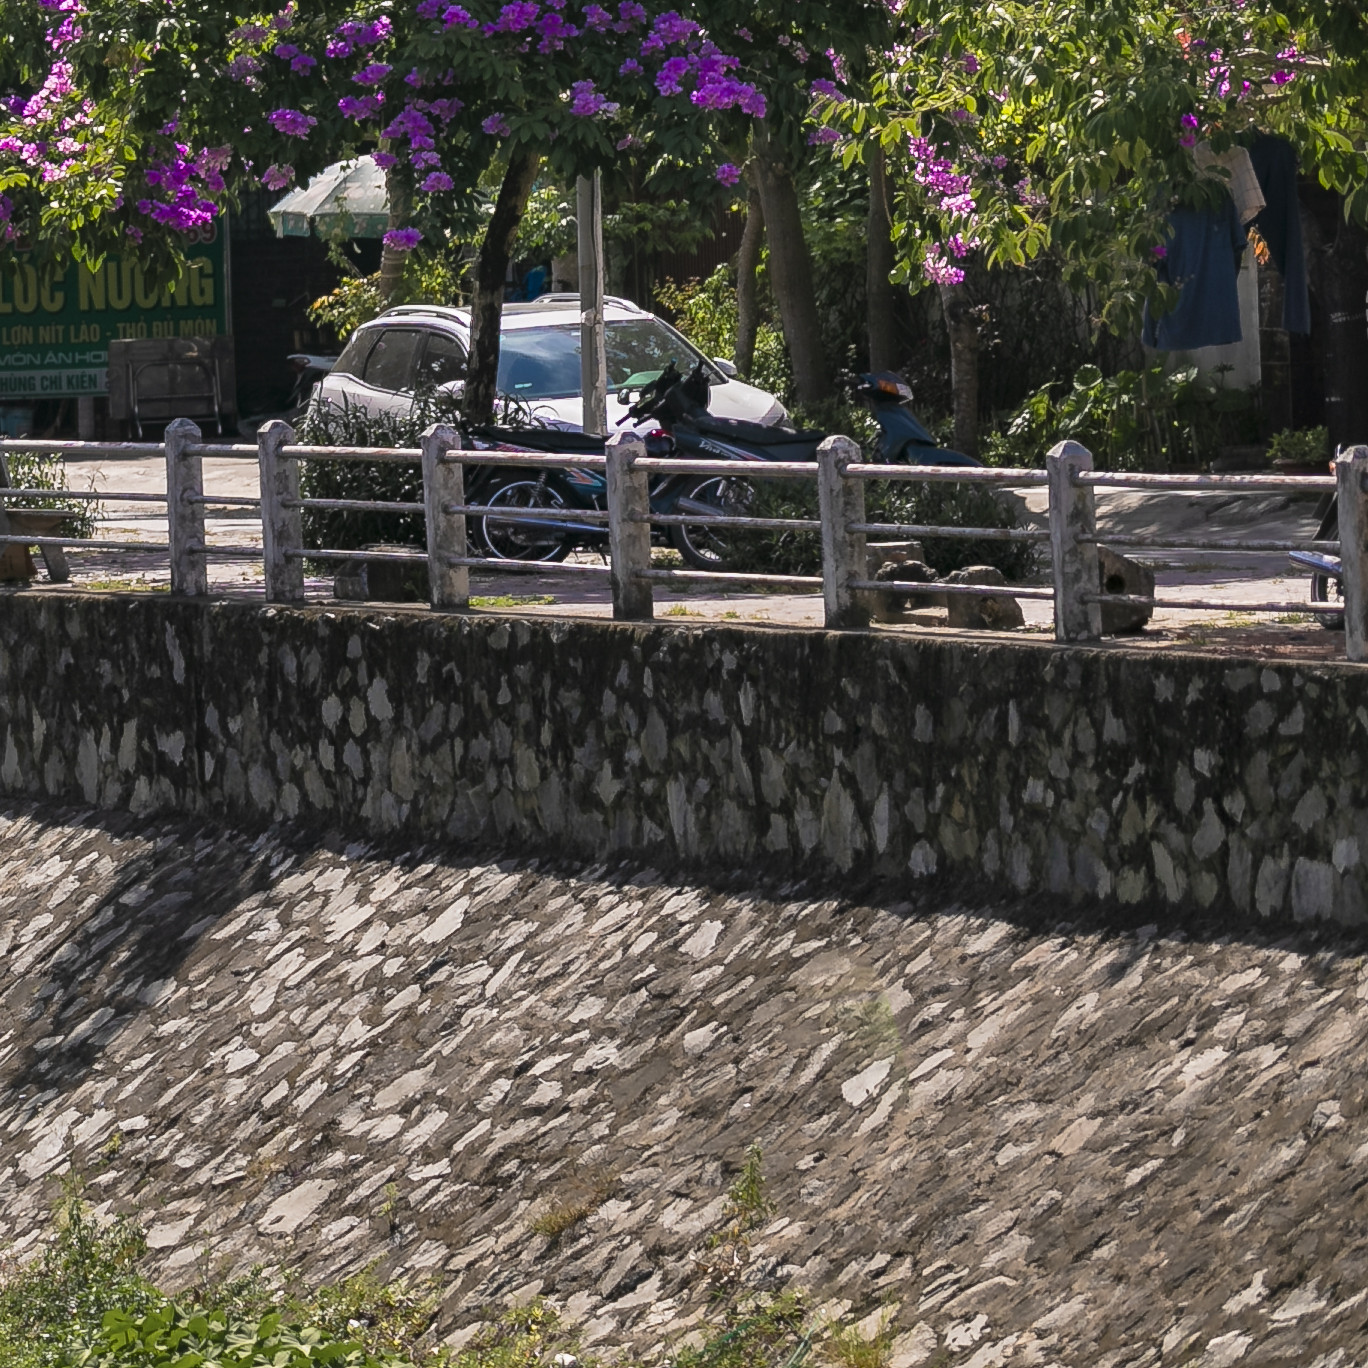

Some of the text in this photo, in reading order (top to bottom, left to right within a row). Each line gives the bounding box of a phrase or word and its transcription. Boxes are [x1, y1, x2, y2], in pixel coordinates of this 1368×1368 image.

[2, 324, 33, 350] LỢN
[40, 371, 62, 391] CHÍ
[66, 370, 97, 390] KIÊN
